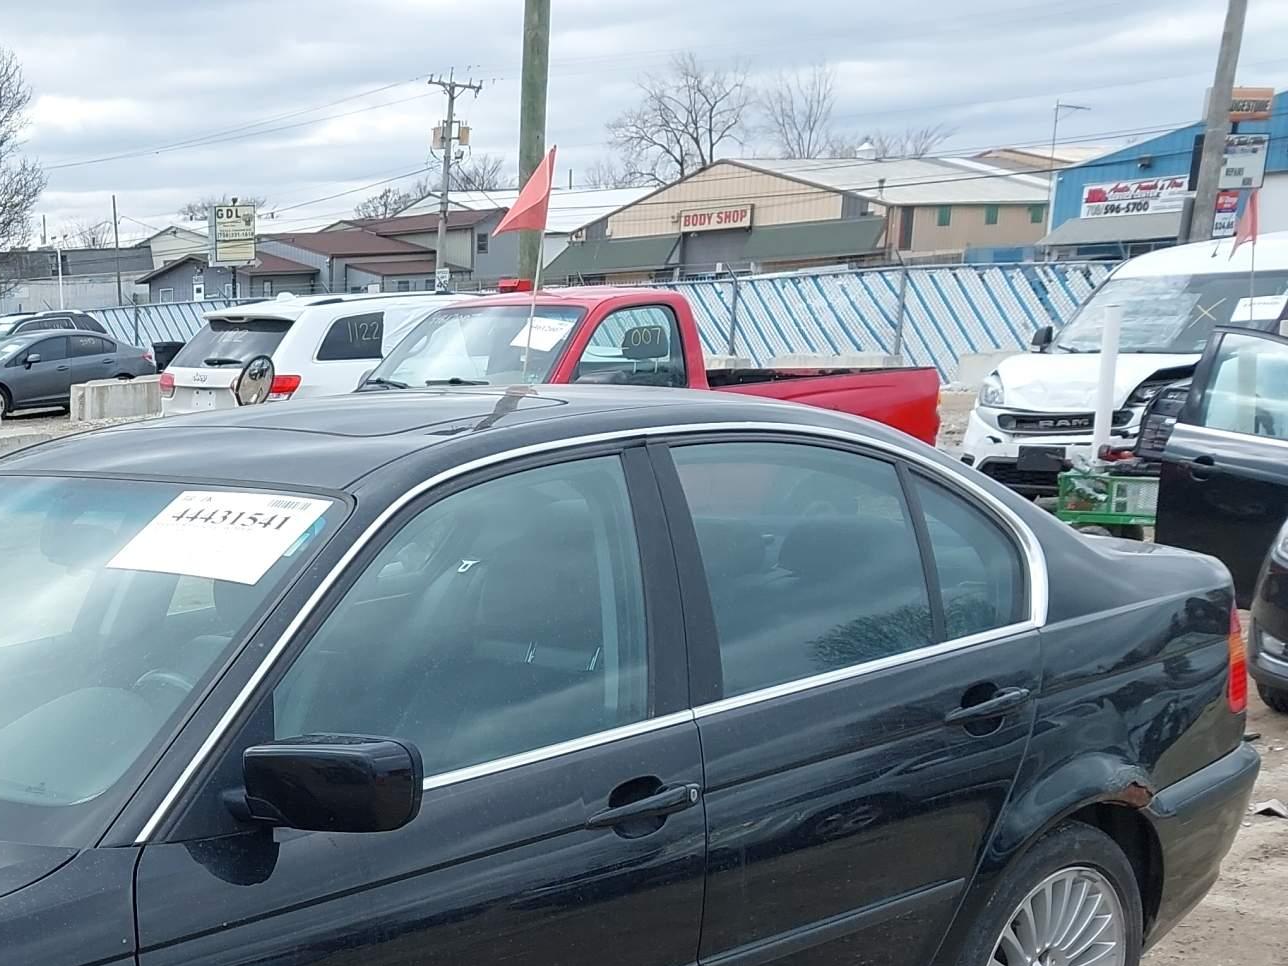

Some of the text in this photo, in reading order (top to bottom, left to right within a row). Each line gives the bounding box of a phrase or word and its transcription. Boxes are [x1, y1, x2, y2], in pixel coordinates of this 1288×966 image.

[216, 208, 241, 219] GDL
[683, 209, 748, 227] BODY SHOP
[347, 322, 380, 342] 1122
[630, 327, 662, 346] 007
[1039, 418, 1089, 429] RAM
[172, 508, 292, 531] 44431541
